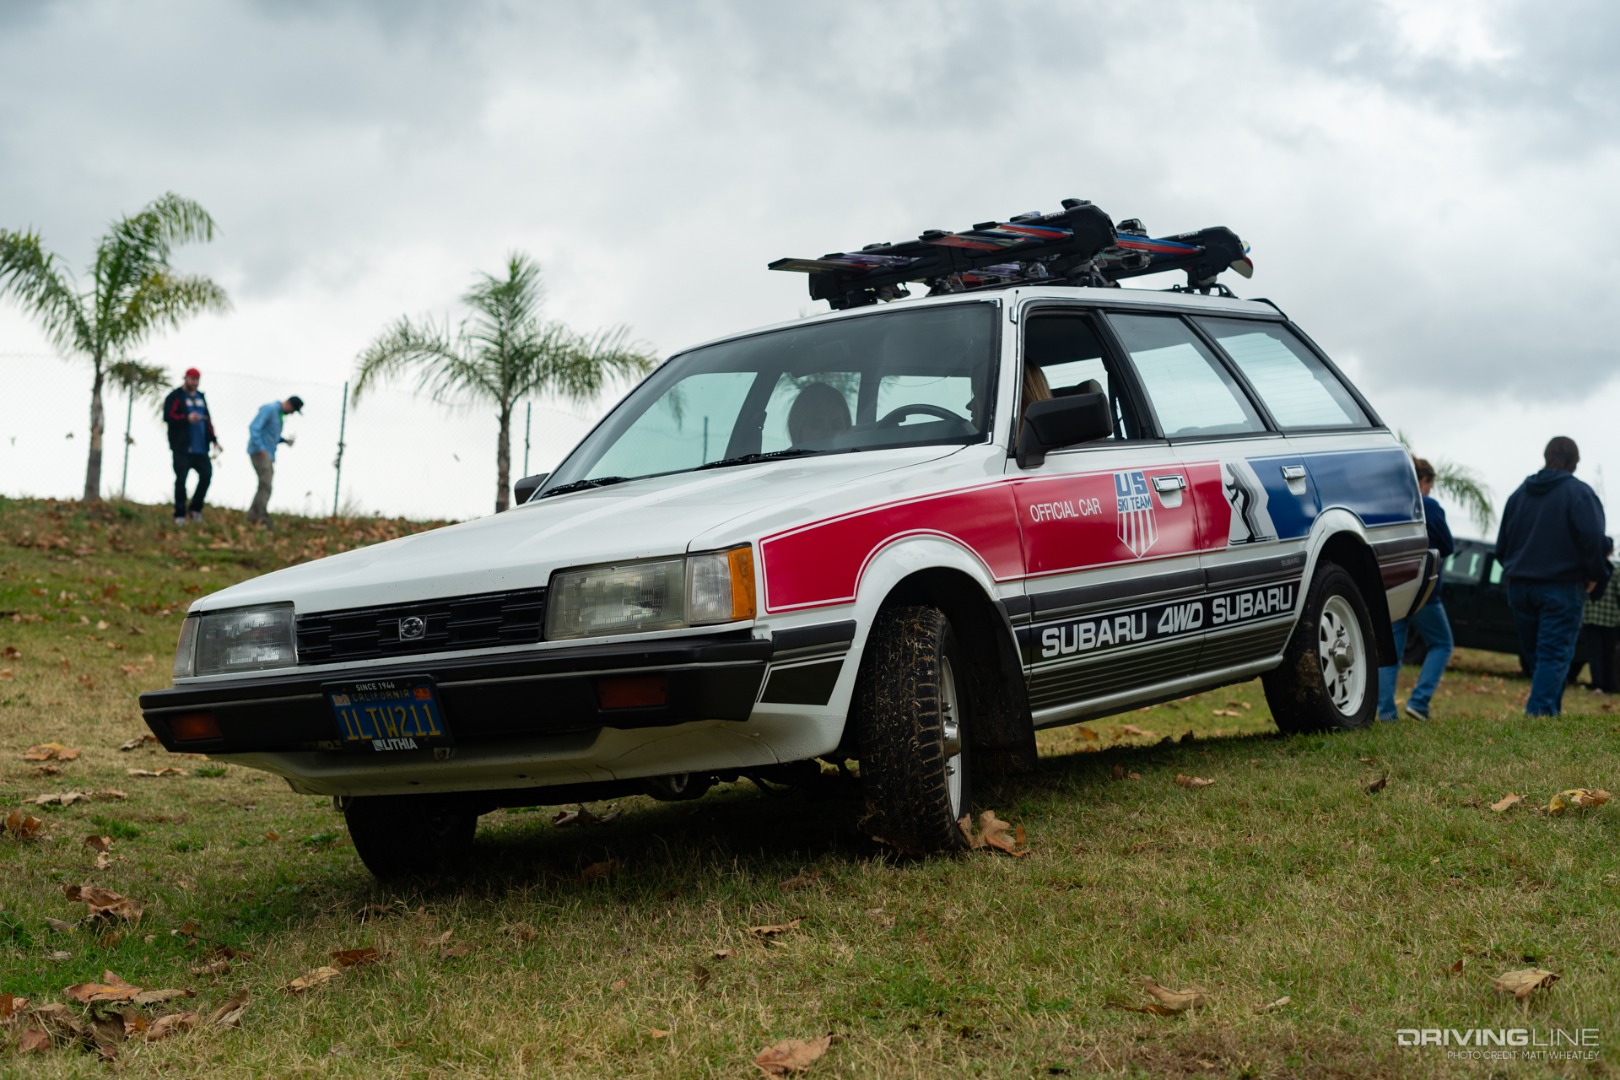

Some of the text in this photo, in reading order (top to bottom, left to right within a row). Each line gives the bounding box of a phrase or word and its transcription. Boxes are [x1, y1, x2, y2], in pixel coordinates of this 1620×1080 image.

[1114, 472, 1149, 497] US
[1029, 497, 1102, 523] OFFICIAL CAR
[1118, 495, 1153, 512] SKI TEAM
[1041, 585, 1293, 658] SUBARU 4WD SUBARU
[351, 689, 410, 702] CALIFORNIA
[355, 681, 395, 691] SINCE 1946
[341, 704, 441, 740] 1LTW211
[382, 738, 418, 751] LITHIA
